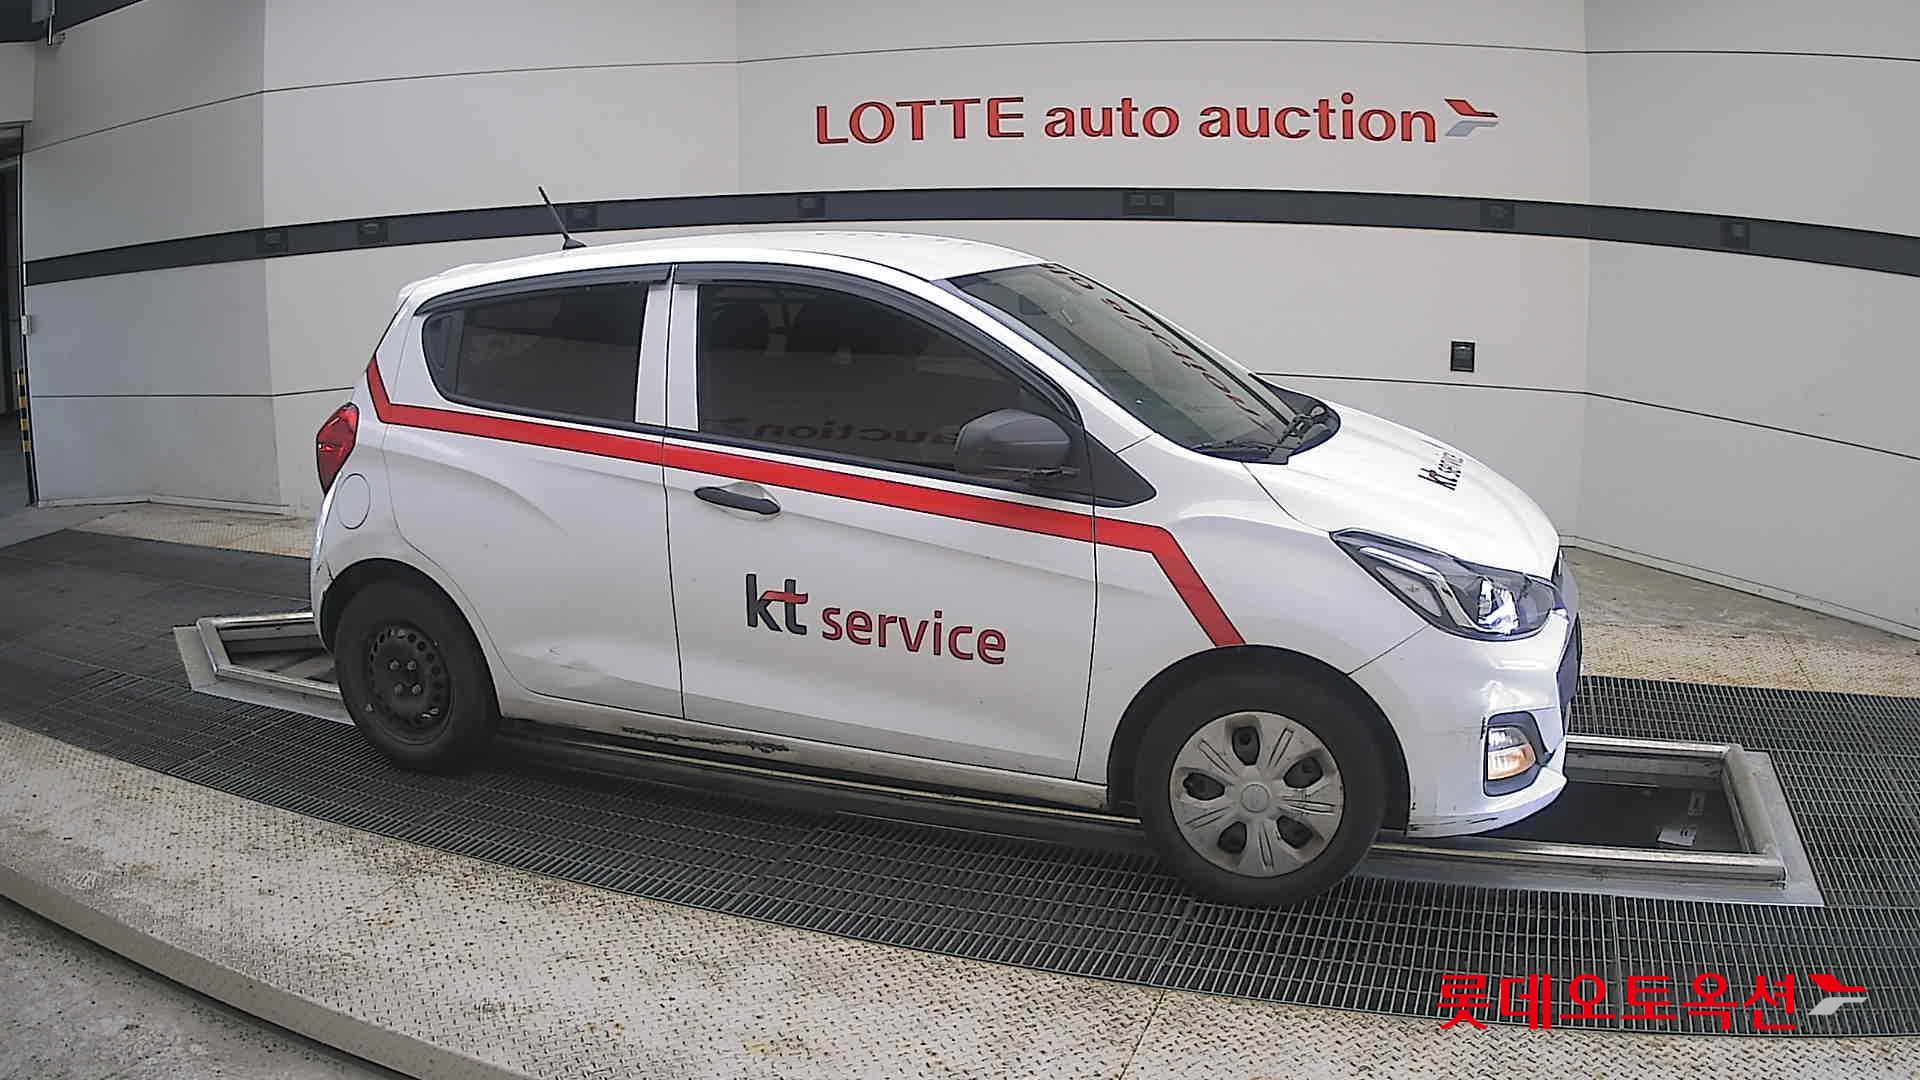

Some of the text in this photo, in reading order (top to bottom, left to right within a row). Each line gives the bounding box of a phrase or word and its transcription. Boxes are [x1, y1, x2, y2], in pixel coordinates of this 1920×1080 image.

[816, 92, 1436, 144] LOTTE auto auction
[746, 573, 1006, 664] kt service
